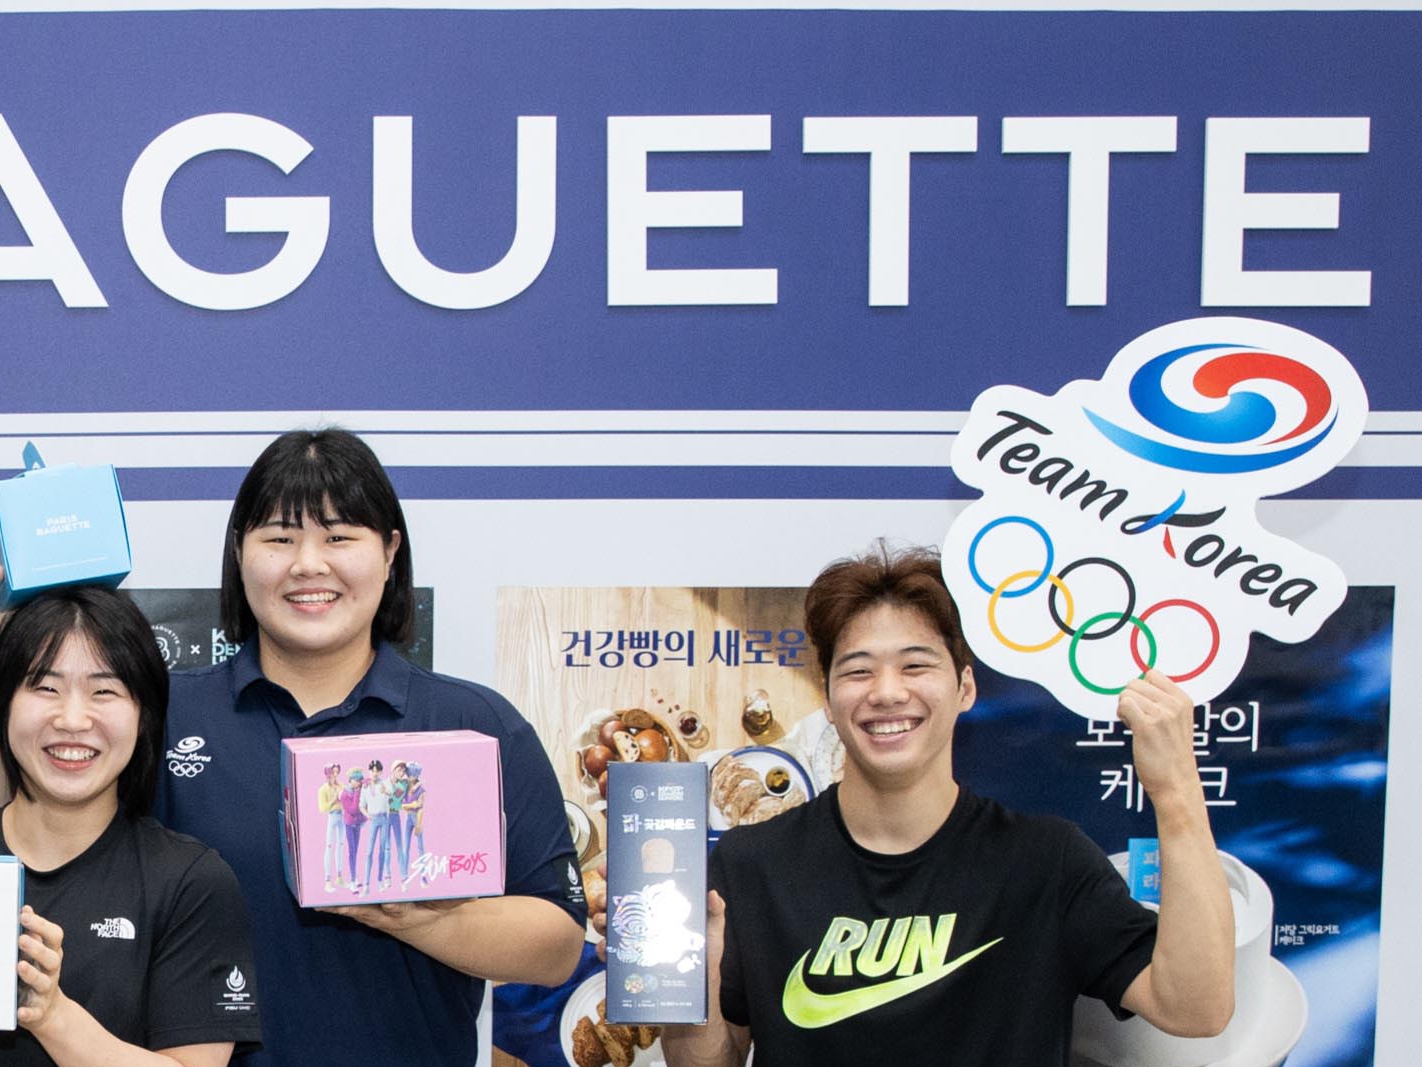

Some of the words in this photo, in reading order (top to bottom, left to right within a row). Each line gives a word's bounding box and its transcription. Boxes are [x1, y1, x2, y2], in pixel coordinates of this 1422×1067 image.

[46, 512, 79, 527] PARIS
[976, 410, 1129, 522] Team
[1119, 488, 1319, 617] Korea
[561, 629, 695, 669] 건강빵의
[707, 628, 810, 668] 새로운
[1100, 763, 1237, 813] 케크
[808, 912, 958, 978] RUN
[1279, 935, 1305, 946] 케이크
[1298, 923, 1341, 935] 그릭요거트
